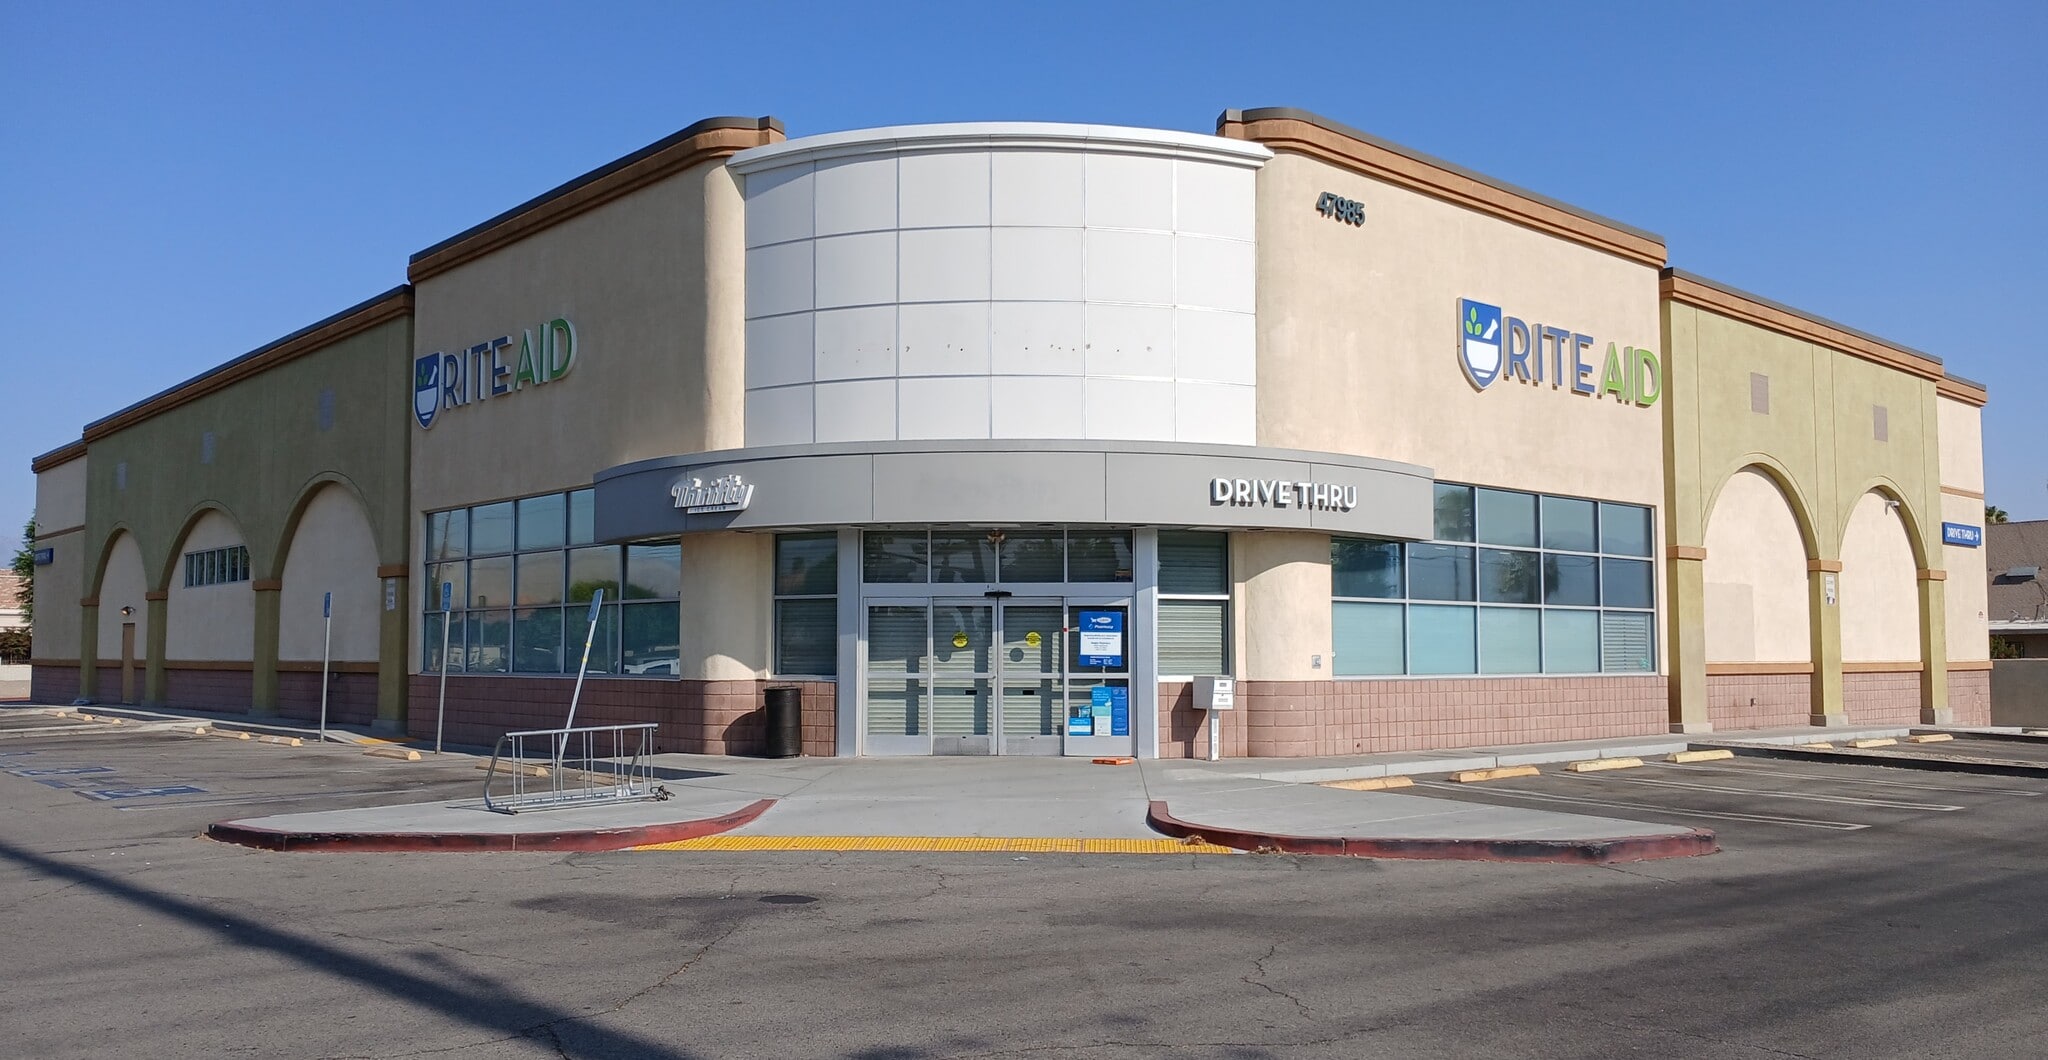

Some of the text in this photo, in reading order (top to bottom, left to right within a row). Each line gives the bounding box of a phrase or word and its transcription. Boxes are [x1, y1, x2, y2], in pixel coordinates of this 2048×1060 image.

[1316, 191, 1365, 226] 47985
[443, 317, 577, 409] RITE AID
[1503, 316, 1661, 406] RITE AID
[671, 475, 754, 509] Thrifty
[1212, 478, 1357, 509] DRIVE THRU
[1946, 526, 1974, 541] DRIVE THRU
